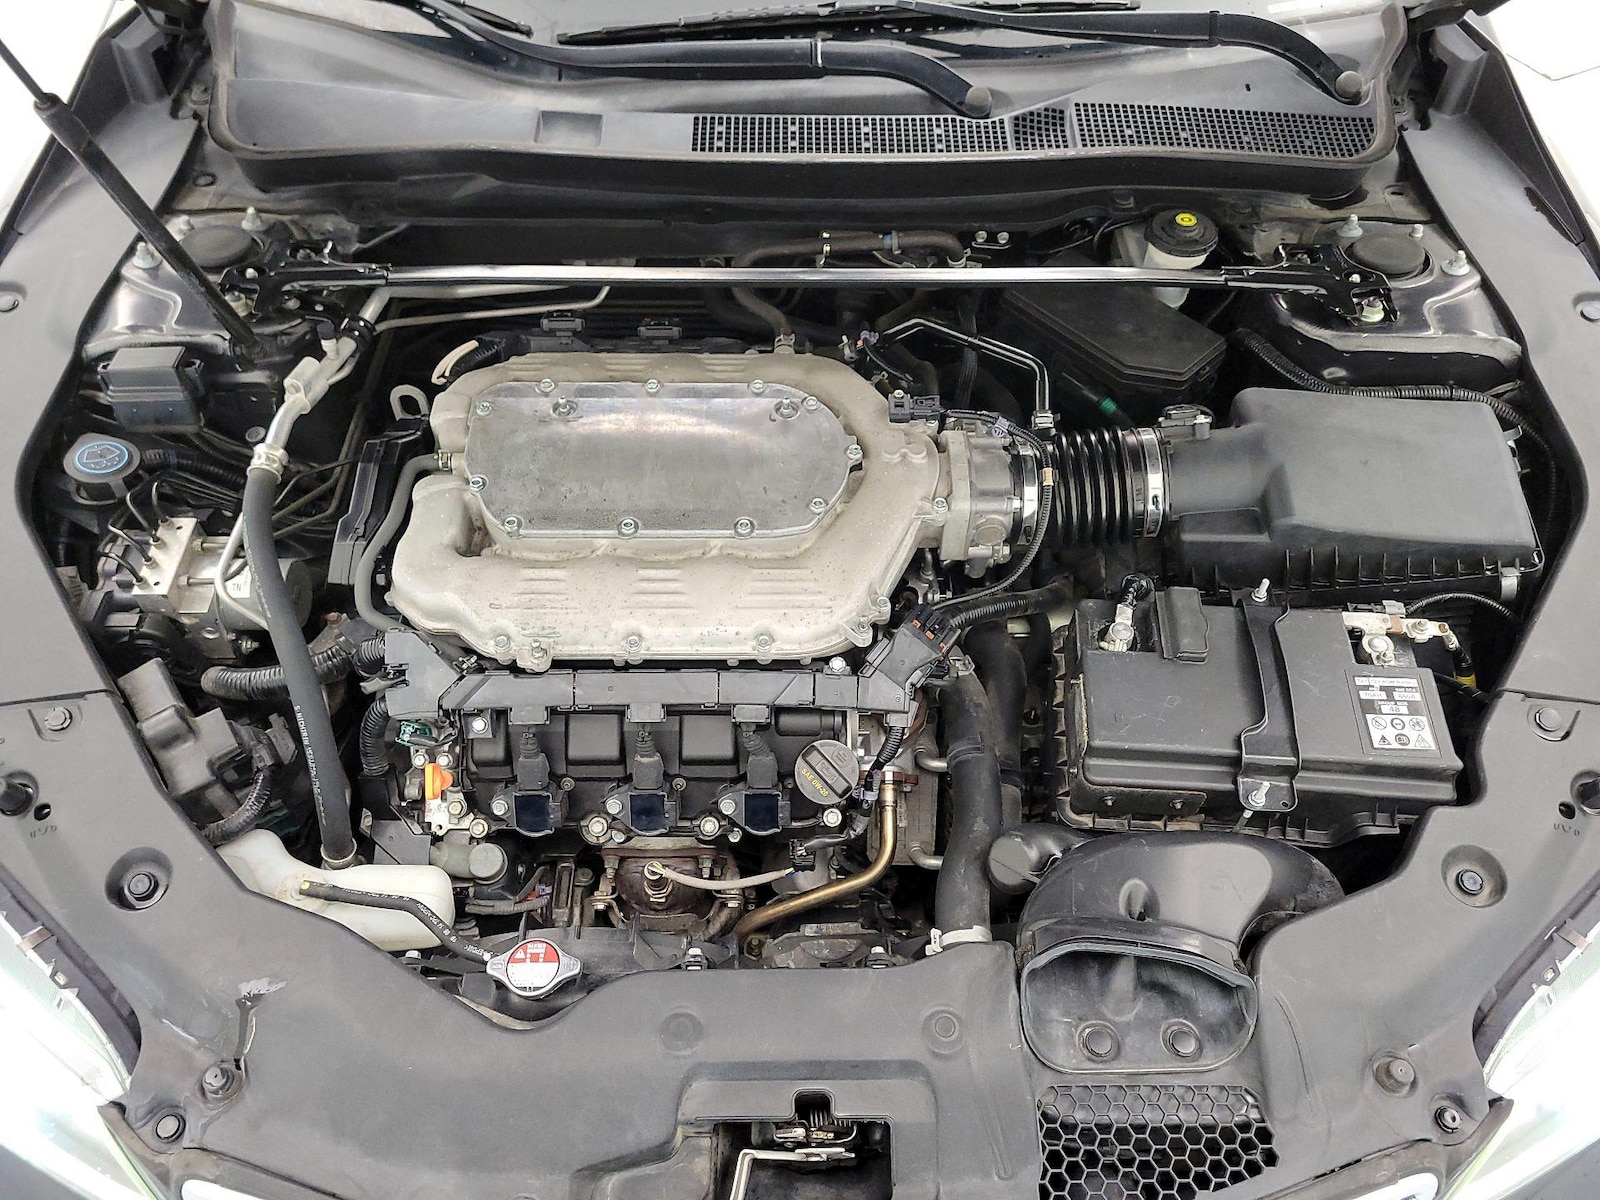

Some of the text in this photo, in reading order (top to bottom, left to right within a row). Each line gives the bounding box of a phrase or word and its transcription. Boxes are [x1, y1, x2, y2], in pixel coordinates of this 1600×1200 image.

[1389, 705, 1401, 713] 48
[801, 768, 829, 797] SAE 0W-20
